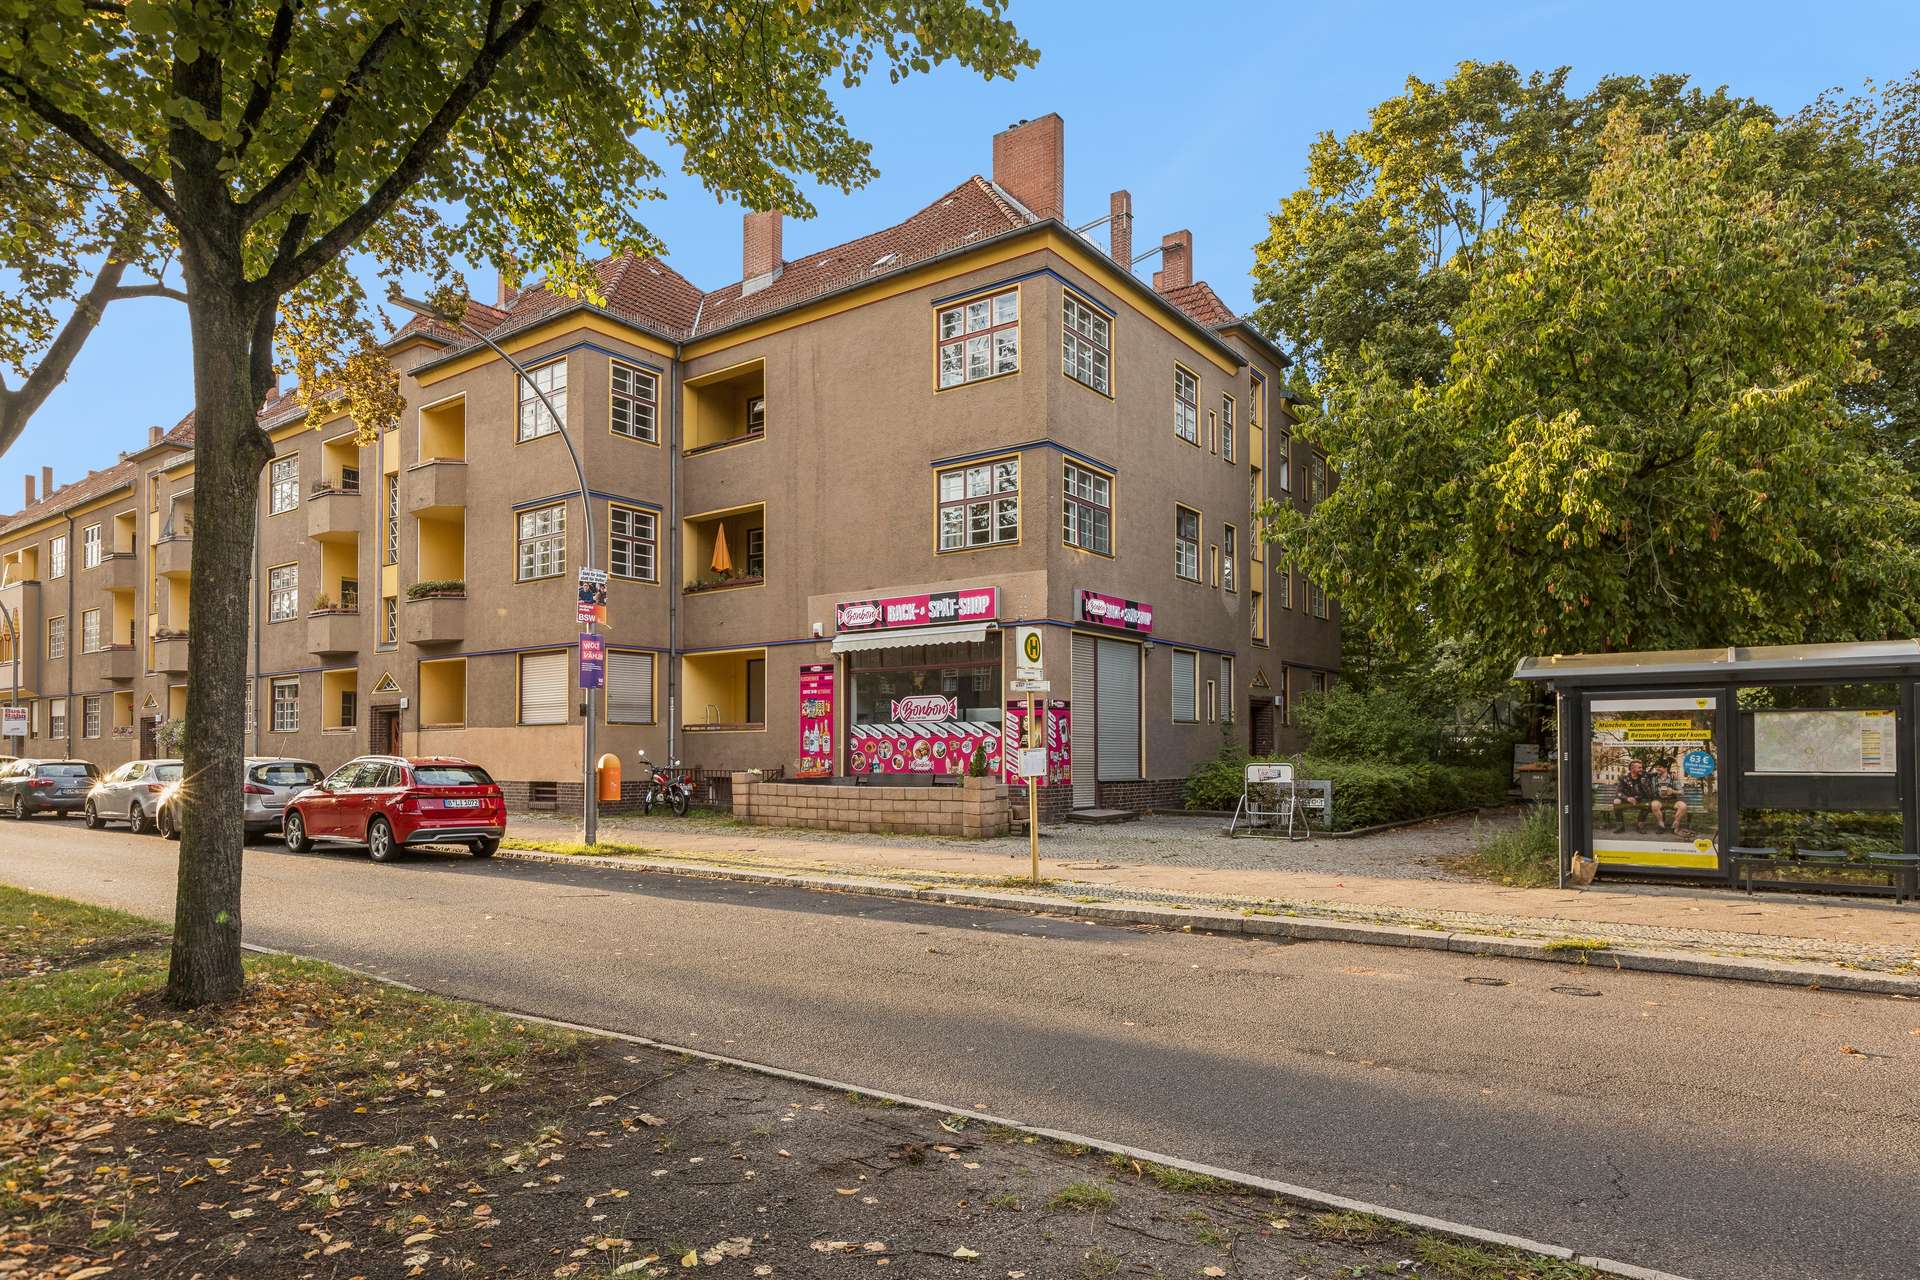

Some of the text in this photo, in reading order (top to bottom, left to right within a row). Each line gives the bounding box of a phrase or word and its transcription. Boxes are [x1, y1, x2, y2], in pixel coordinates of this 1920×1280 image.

[845, 606, 875, 623] Bonbon
[927, 595, 990, 618] SPÄT-SHOP
[578, 614, 596, 622] BSW
[1030, 639, 1038, 656] H
[903, 700, 947, 721] Bonbon
[1690, 755, 1709, 764] 63 €
